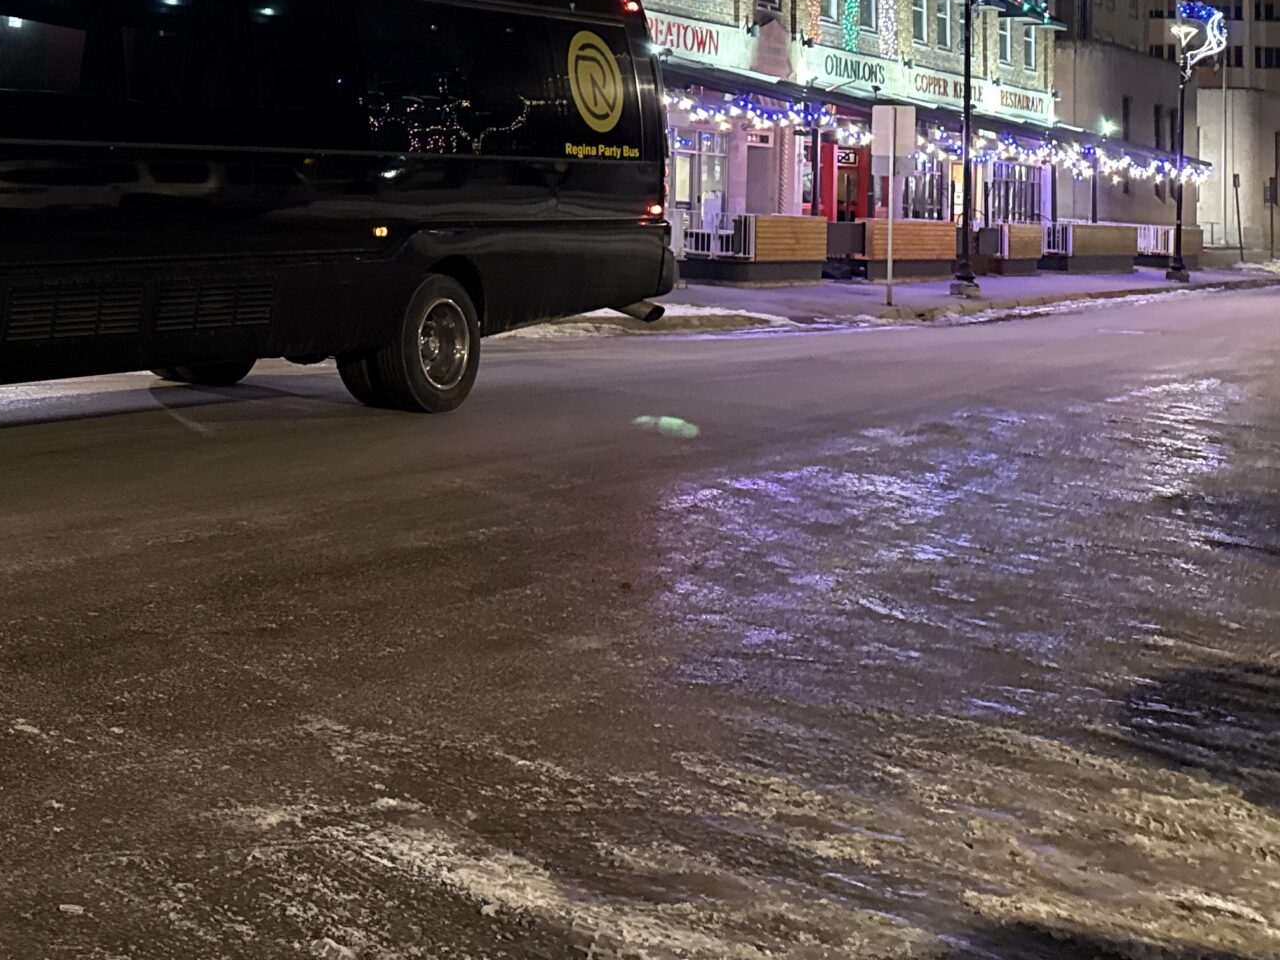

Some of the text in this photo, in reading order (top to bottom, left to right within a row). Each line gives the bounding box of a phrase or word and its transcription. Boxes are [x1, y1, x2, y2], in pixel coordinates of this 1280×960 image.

[825, 54, 885, 85] O'HANLON'S
[915, 73, 1045, 114] COPPER KETLE RESTAURANT
[565, 142, 640, 160] Regina Party Bus
